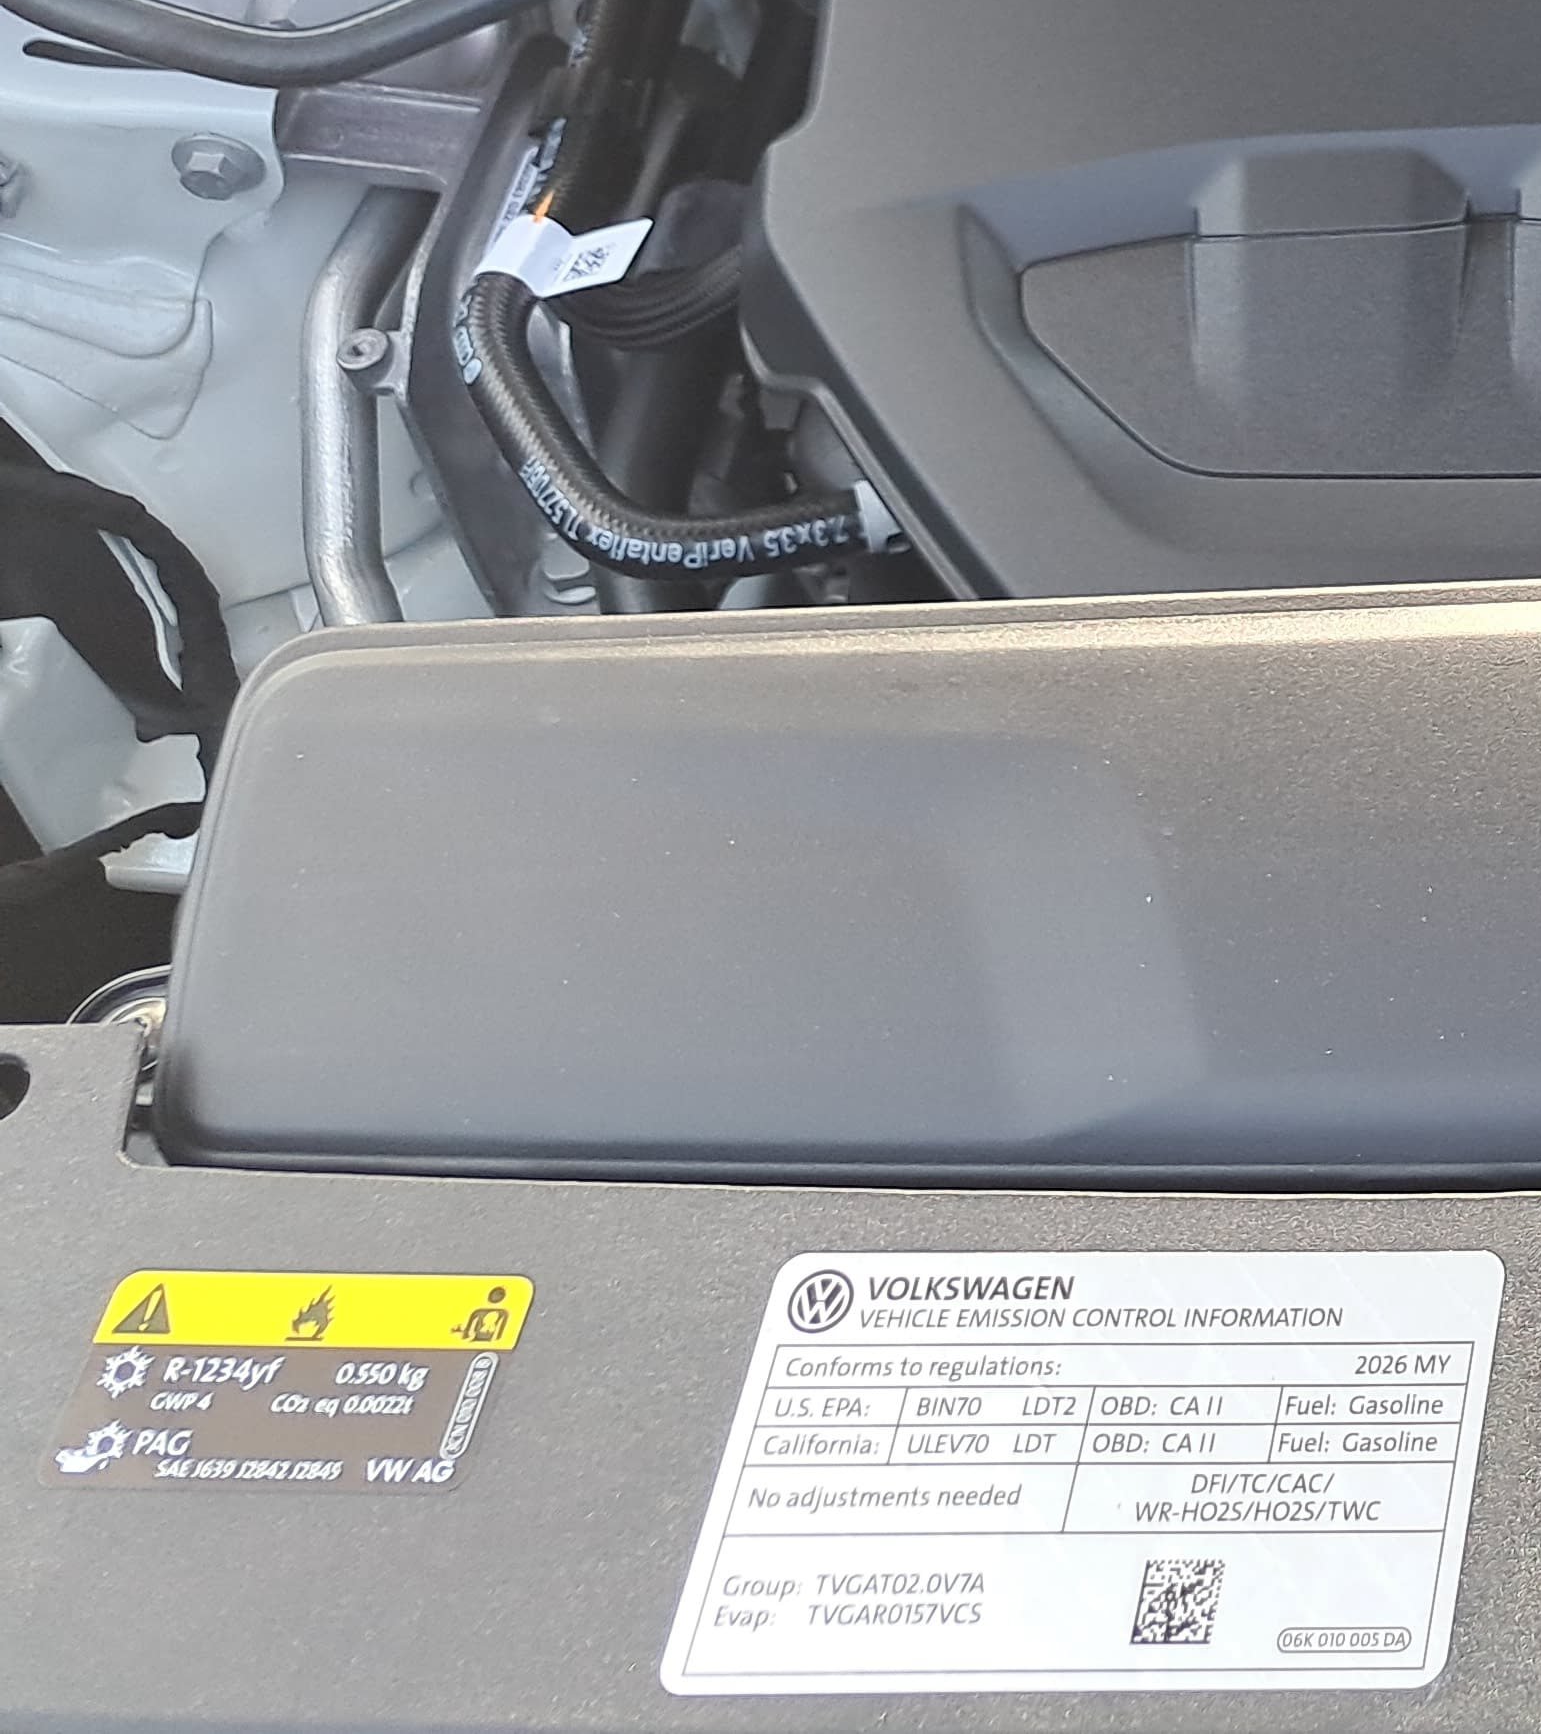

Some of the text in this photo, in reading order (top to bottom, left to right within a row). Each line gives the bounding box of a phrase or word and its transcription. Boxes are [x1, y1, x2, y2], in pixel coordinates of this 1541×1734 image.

[870, 1276, 1074, 1300] VOLKSWAGEN
[861, 1308, 1343, 1328] VEHICLE EMISSION CONTROL INFORMATION
[163, 1356, 286, 1391] R-1234yf
[397, 1362, 429, 1391] kg
[786, 1355, 1061, 1382] Conforms to regulations:
[1355, 1355, 1451, 1374] 2026 MY
[775, 1398, 870, 1417] U.S. EPA:
[917, 1397, 1076, 1416] BIN70 LDT2
[1101, 1396, 1157, 1415] OBD:
[1285, 1394, 1443, 1415] Fuel: Gasoline
[132, 1429, 193, 1456] PAG
[764, 1434, 878, 1455] California:
[908, 1434, 1057, 1454] ULEV70 LDT
[1093, 1433, 1149, 1453] OBD:
[1278, 1431, 1437, 1452] Fuel: Gasoline
[366, 1458, 456, 1483] VW AG
[1191, 1473, 1335, 1493] DFI/TC/CAC/
[749, 1484, 1022, 1514] No adjustments needed
[1136, 1501, 1381, 1522] WR-HO2S/HO2S/TWC
[723, 1573, 984, 1602] Group: TVGAT02.0V7A
[714, 1603, 981, 1631] Evap: TVGAR0157VCS
[1283, 1632, 1405, 1648] 06K 010 005 DA
